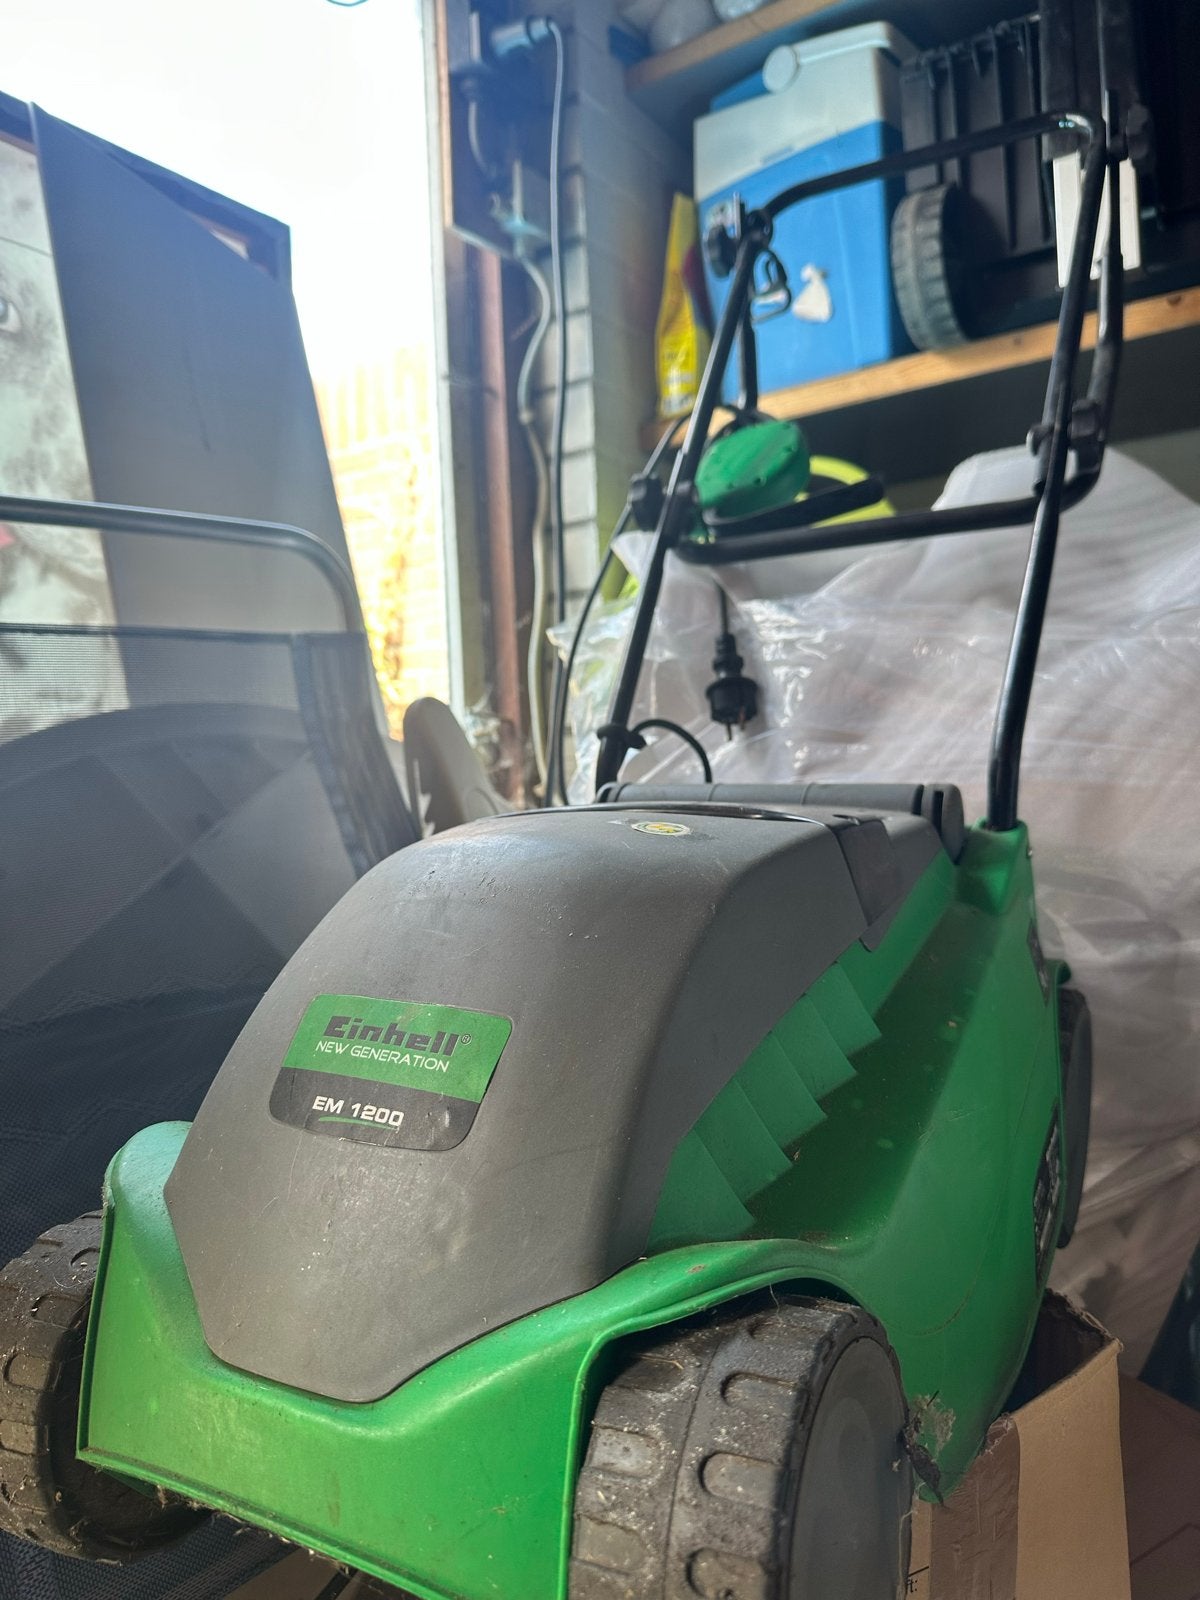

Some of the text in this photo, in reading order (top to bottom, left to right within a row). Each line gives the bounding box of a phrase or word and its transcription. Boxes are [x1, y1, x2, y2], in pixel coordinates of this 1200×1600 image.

[316, 1040, 450, 1073] NEW GENERATION
[312, 1096, 405, 1126] EM 1200
